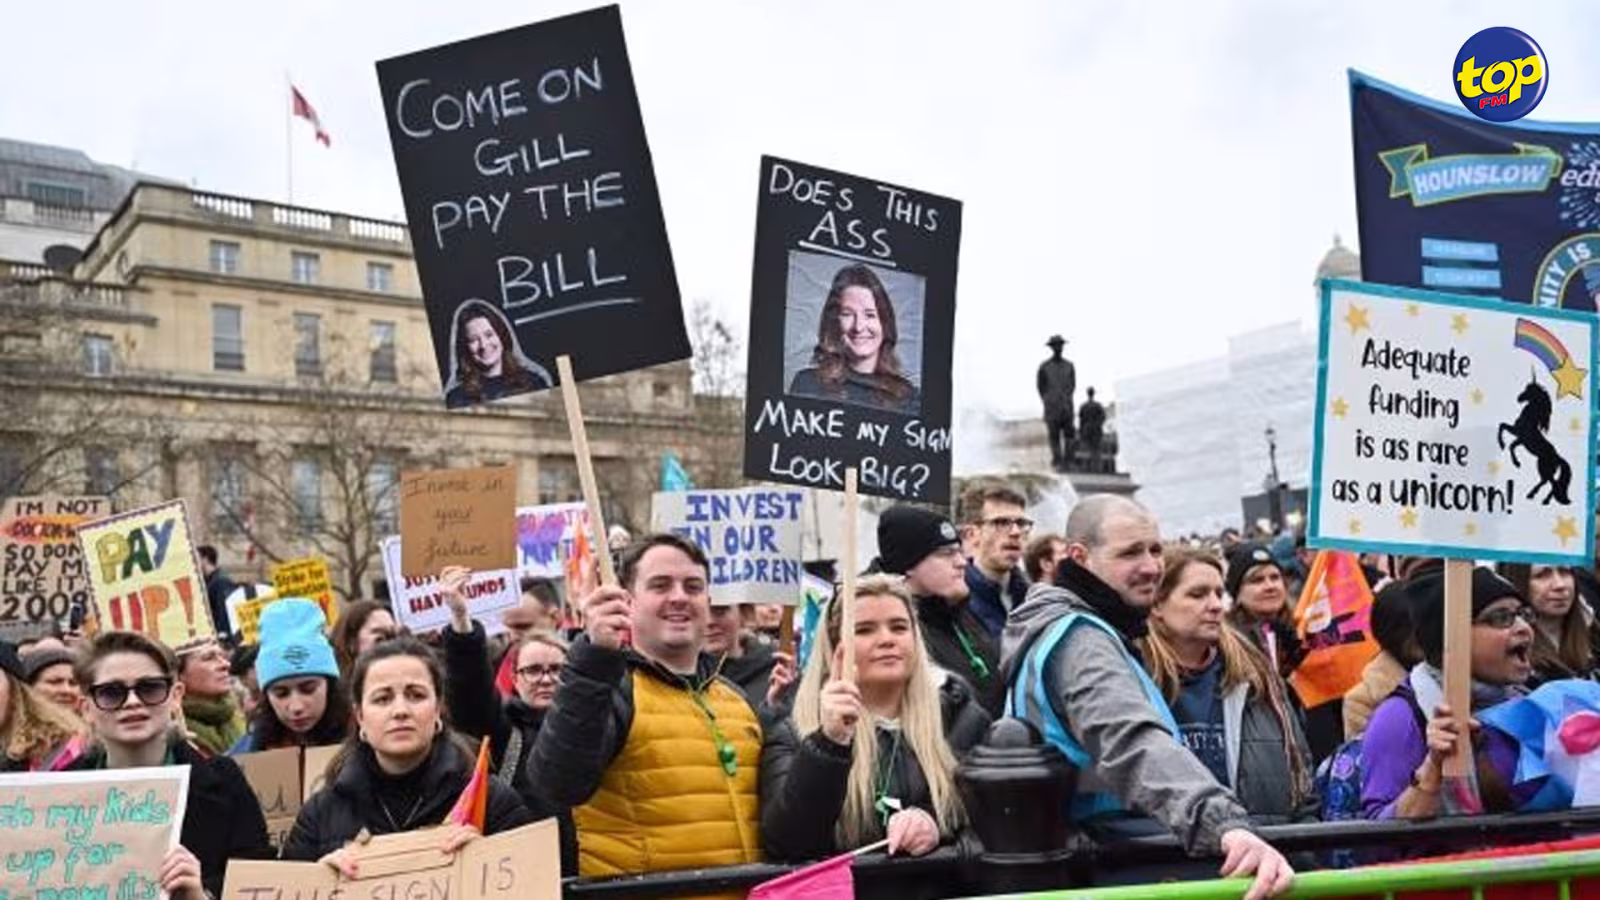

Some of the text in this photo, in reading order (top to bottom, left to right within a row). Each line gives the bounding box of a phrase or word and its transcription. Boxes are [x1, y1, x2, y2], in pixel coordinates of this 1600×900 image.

[397, 57, 602, 137] COME ON
[474, 133, 591, 176] GILL
[769, 164, 938, 232] DOES THIS
[1414, 164, 1547, 195] HOUNSLOW
[432, 172, 624, 249] PAY THE
[808, 210, 892, 258] ASS
[1567, 242, 1591, 264] IS
[497, 247, 627, 309] BILL
[1361, 338, 1471, 380] Adequate
[754, 399, 844, 437] MAKE
[1369, 384, 1459, 429] funding
[1356, 429, 1469, 467] is as rare
[770, 443, 930, 497] LOOK BIG?
[16, 500, 102, 515] I'M NOT
[686, 492, 803, 521] INVEST
[1332, 473, 1514, 514] as a unicorn!
[5, 544, 35, 562] SO
[96, 519, 175, 584] PAY
[724, 525, 779, 556] OUR
[3, 577, 47, 594] LIKE
[5, 560, 49, 578] PAY
[466, 577, 506, 599] UNDS
[708, 557, 799, 584] ILDREN
[109, 576, 195, 641] UP!
[46, 804, 97, 844] my
[7, 850, 54, 886] up
